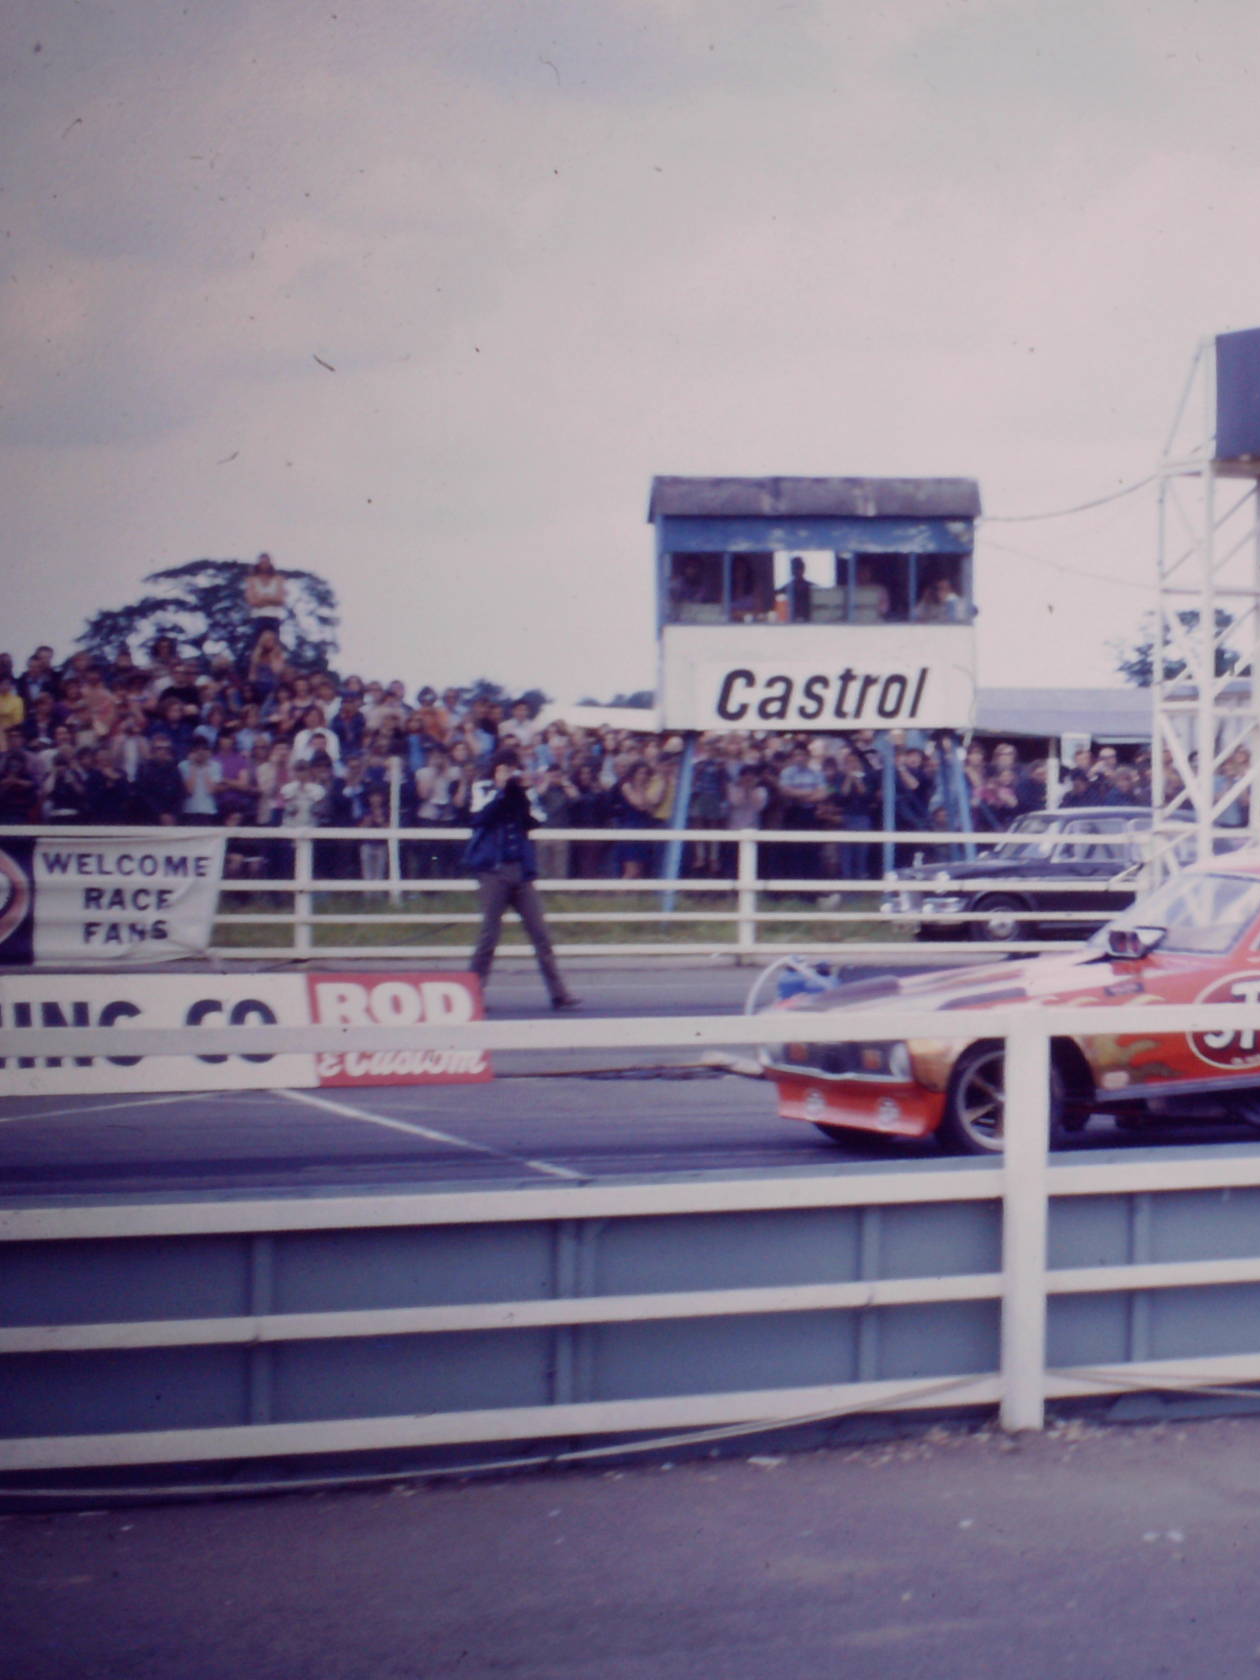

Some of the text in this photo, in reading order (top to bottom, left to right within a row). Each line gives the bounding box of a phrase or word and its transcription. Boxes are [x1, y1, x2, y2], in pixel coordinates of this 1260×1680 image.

[716, 667, 930, 721] Castrol
[42, 852, 211, 877] WELCOME
[83, 887, 174, 912] RACE
[82, 919, 169, 944] FANS
[315, 981, 473, 1024] ROD
